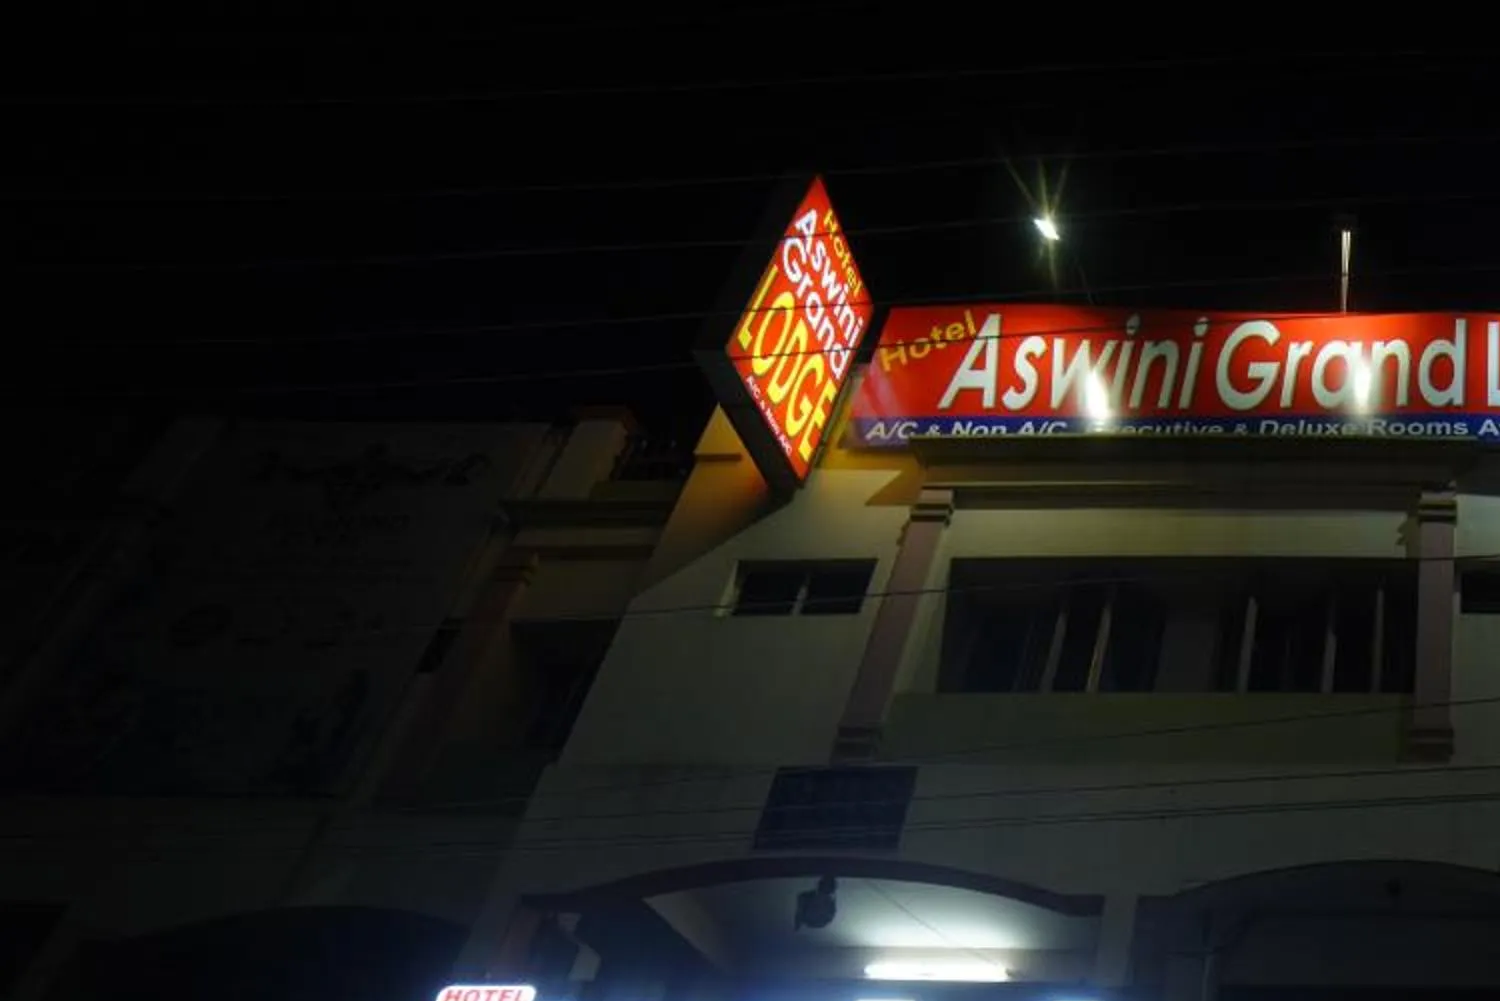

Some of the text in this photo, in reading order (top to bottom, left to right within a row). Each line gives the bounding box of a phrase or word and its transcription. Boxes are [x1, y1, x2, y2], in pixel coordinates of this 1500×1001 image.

[795, 208, 864, 348] Aswini
[823, 208, 864, 297] Hotel
[783, 237, 849, 378] Grand
[878, 309, 976, 371] Hotel
[738, 264, 837, 462] LODGE
[937, 313, 1209, 410] Aswini
[1215, 318, 1467, 410] Grand
[866, 421, 917, 440] A/C
[951, 420, 1007, 437] Non
[1259, 419, 1358, 438] Deluxe
[1366, 419, 1469, 437] Rooms
